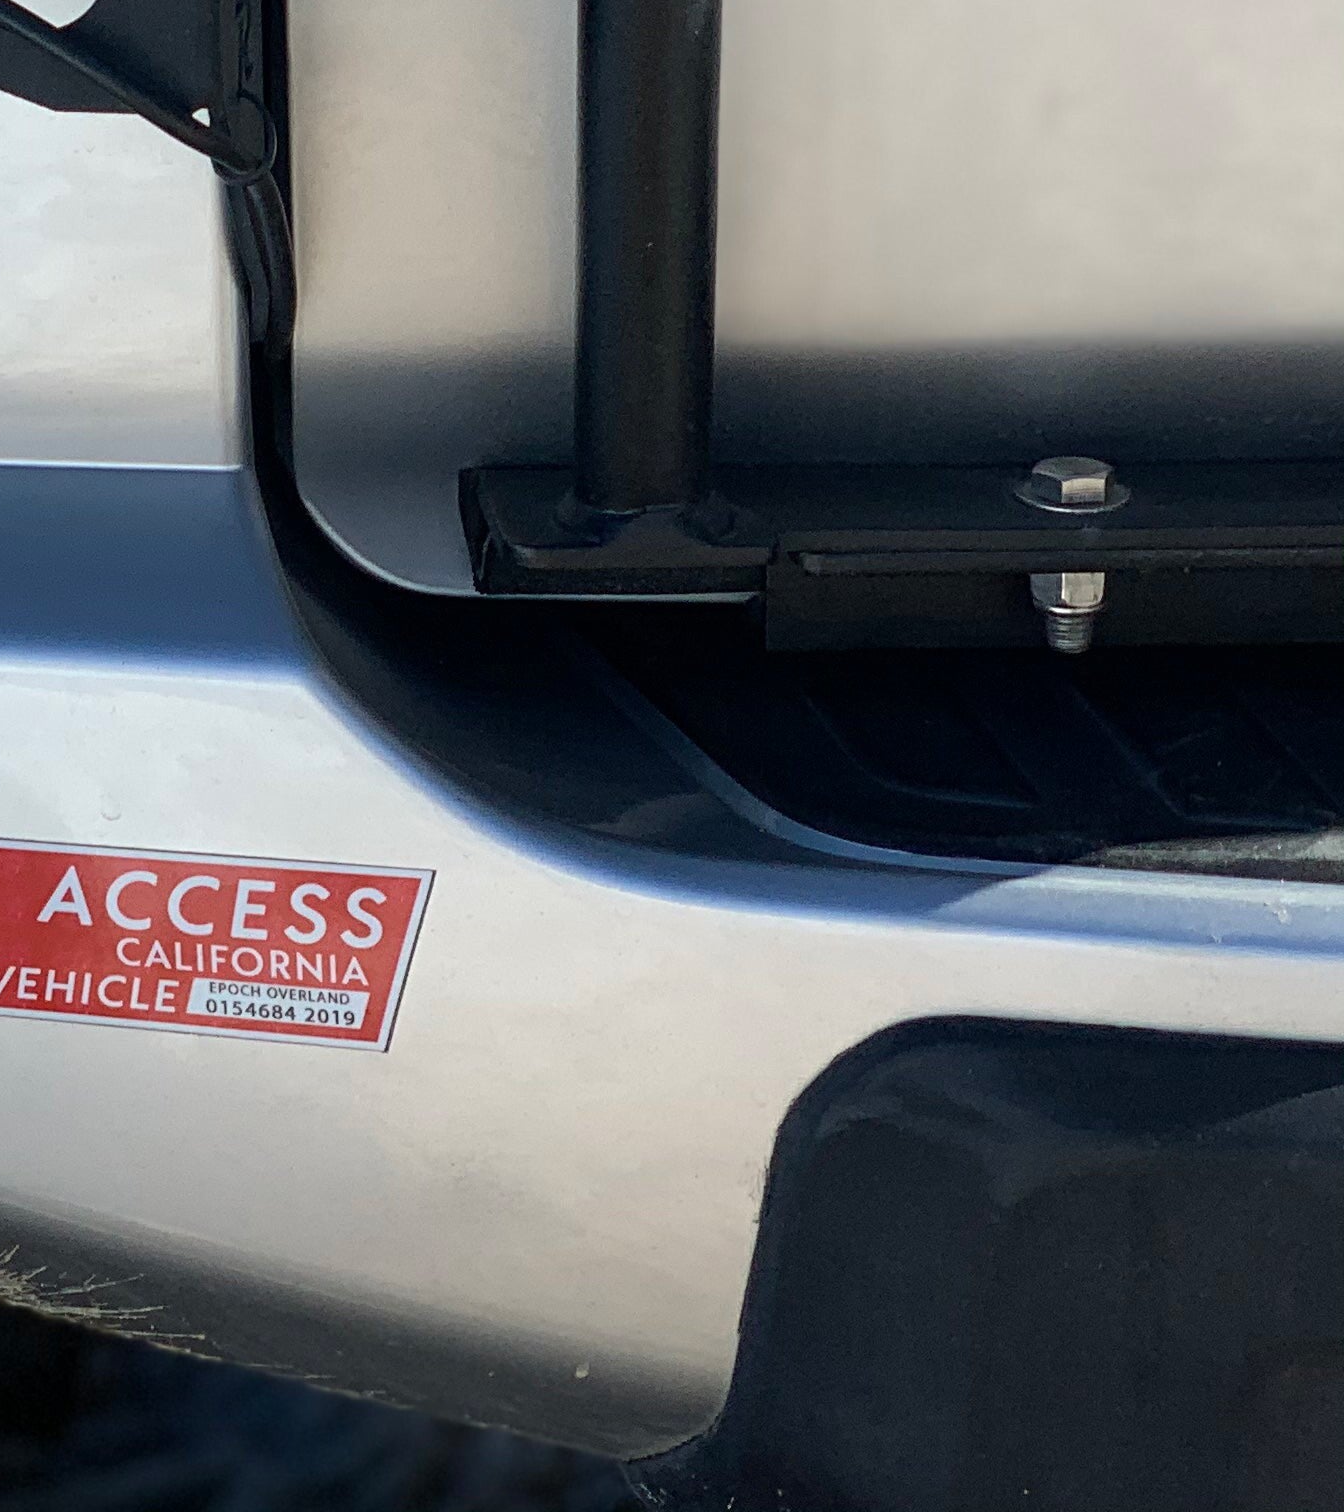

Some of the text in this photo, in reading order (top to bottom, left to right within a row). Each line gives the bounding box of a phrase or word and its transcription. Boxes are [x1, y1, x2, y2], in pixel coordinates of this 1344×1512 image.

[37, 865, 387, 949] ACCESS
[115, 936, 369, 986] CALIFORNIA
[206, 999, 355, 1025] 0154684 2019
[209, 981, 350, 1005] EPOCH OVERLAND
